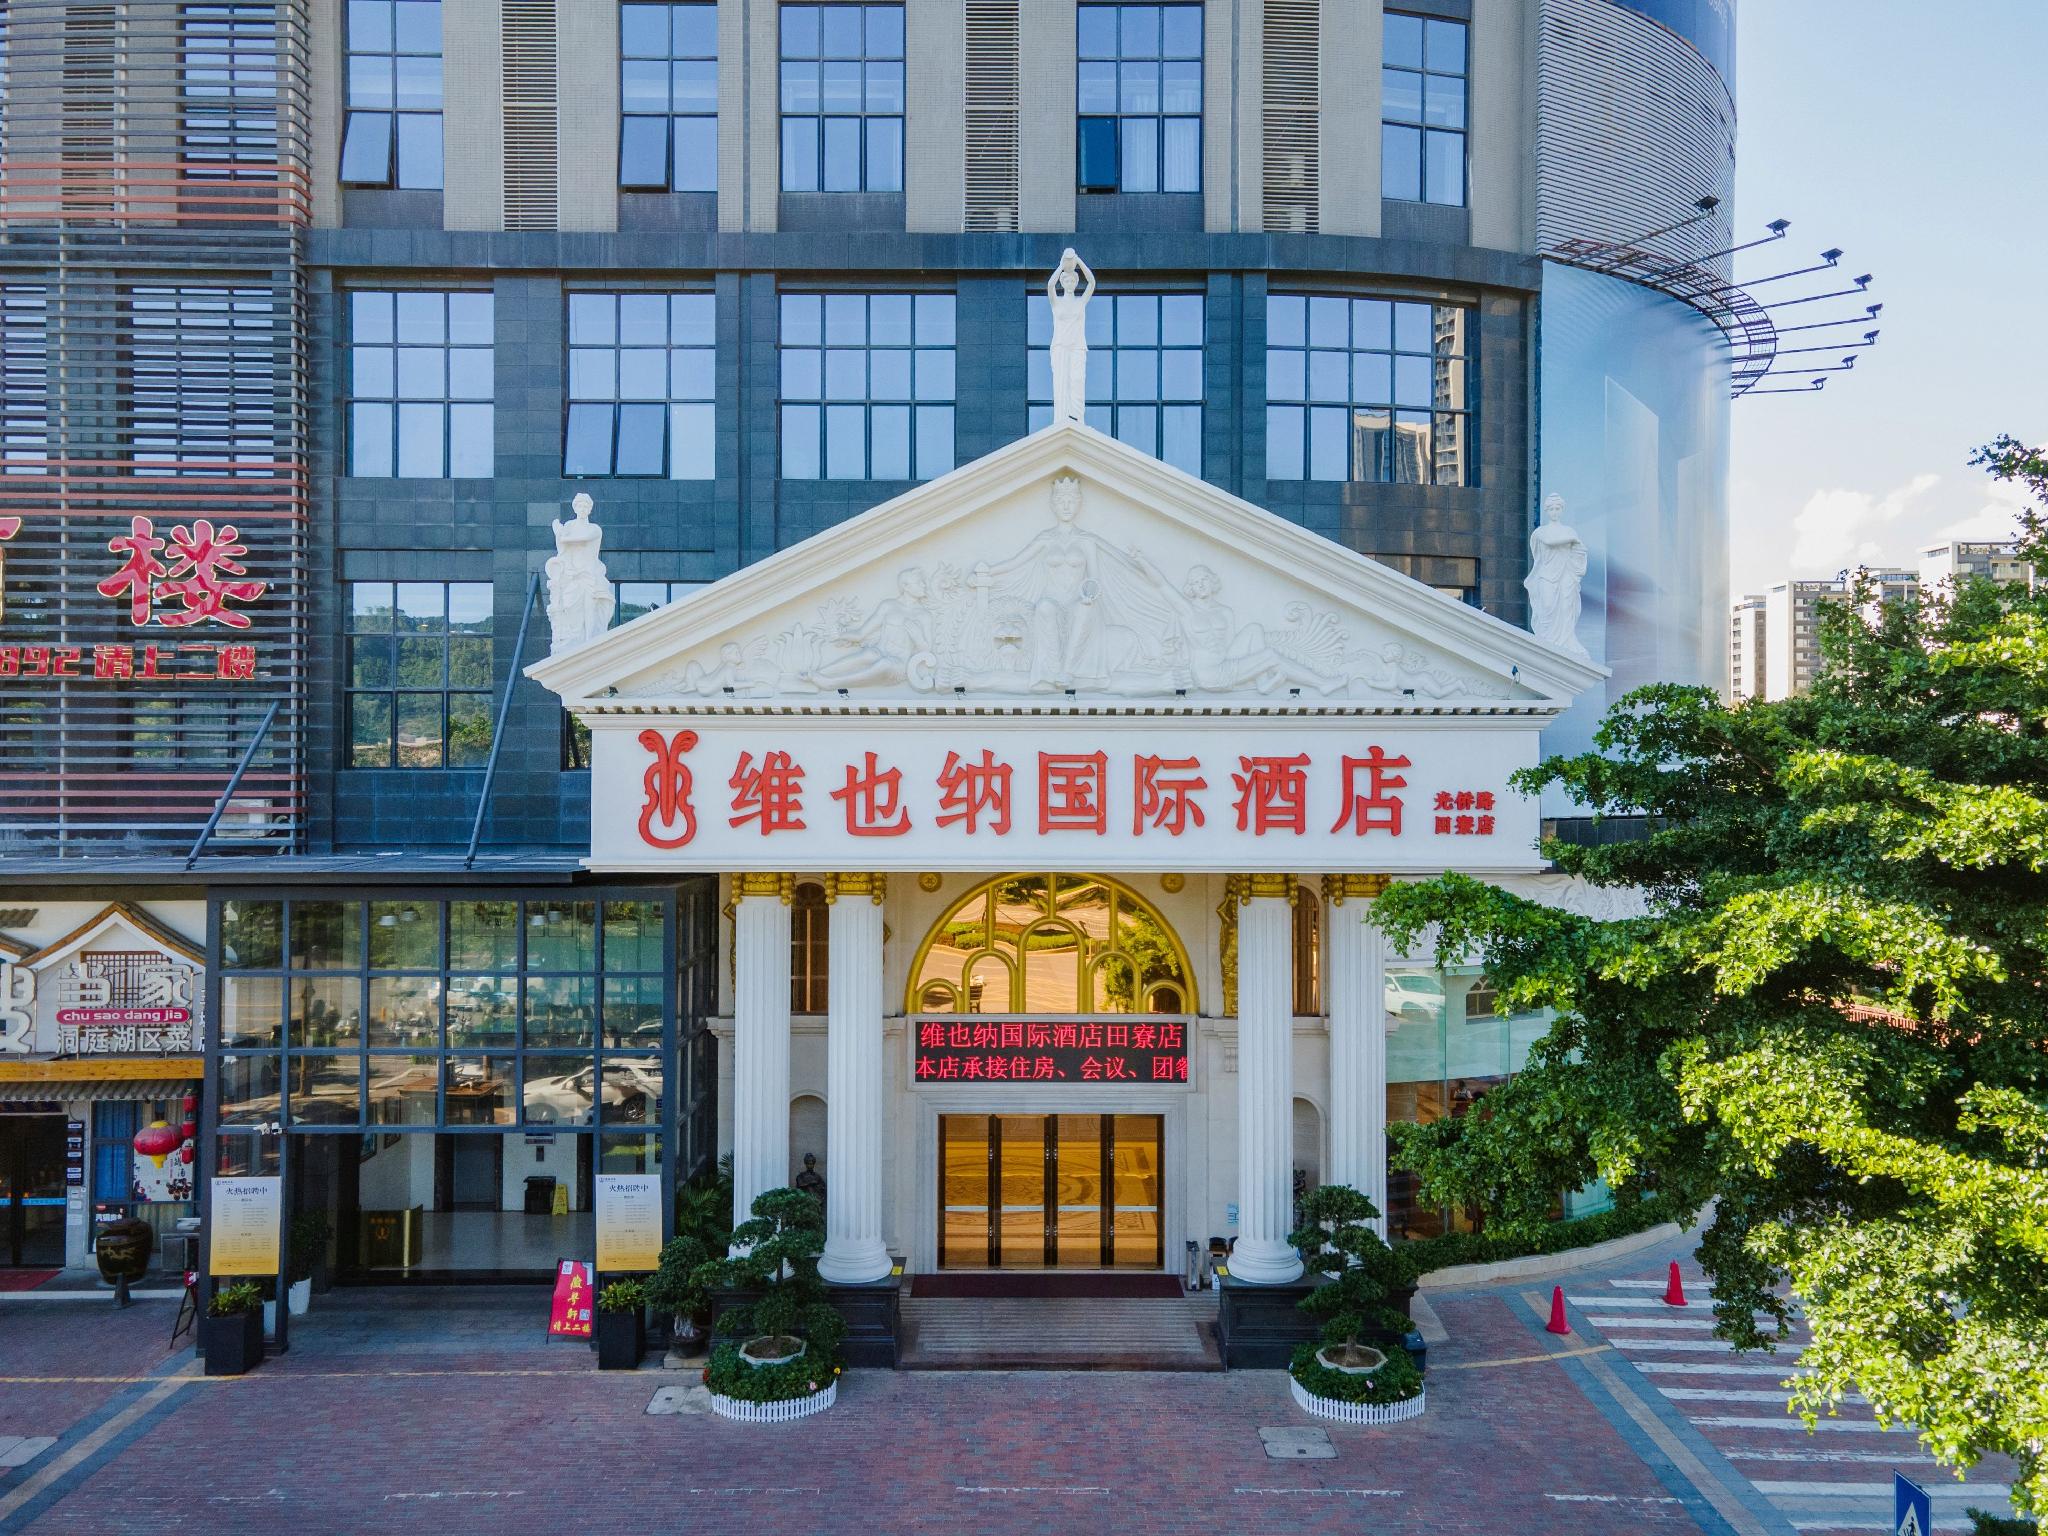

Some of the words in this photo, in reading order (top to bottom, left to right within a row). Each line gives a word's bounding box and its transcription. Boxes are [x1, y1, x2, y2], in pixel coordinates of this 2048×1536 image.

[729, 746, 1410, 836] 维也纳国际酒店
[1434, 814, 1496, 835] 田寮店
[63, 1011, 90, 1021] chu
[93, 1012, 120, 1020] sao
[124, 1010, 161, 1021] dang
[164, 1009, 183, 1021] jia
[57, 1026, 191, 1053] 洞庭湖区菜
[920, 1023, 1183, 1049] 维也纳国际酒店田寮店
